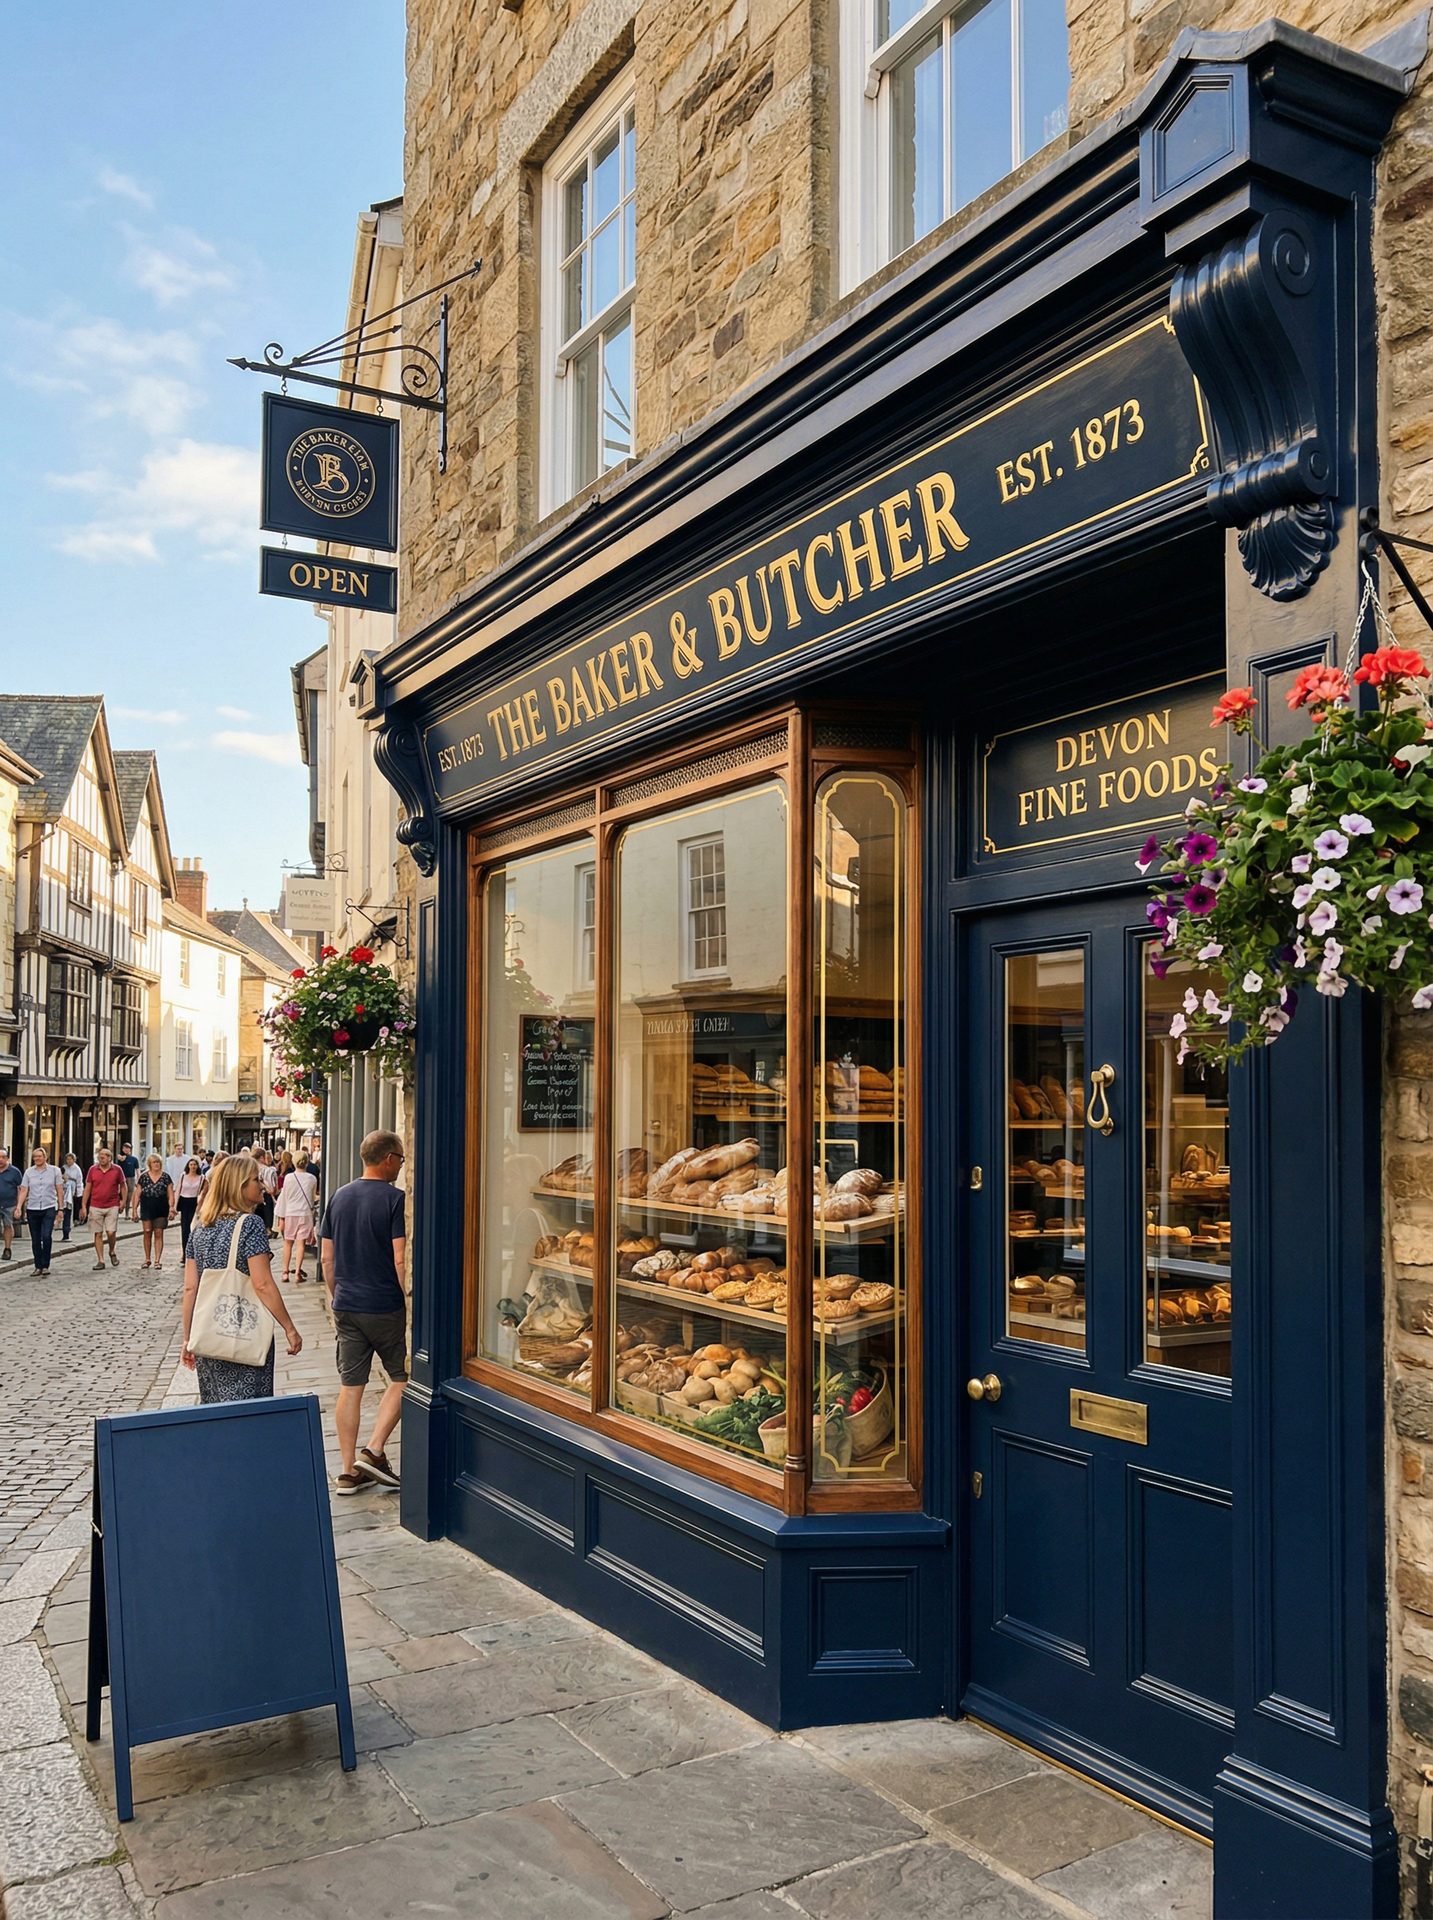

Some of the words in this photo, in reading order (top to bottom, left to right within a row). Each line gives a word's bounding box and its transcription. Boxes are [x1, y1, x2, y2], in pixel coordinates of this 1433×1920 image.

[292, 438, 312, 460] THE
[308, 432, 349, 448] BAKER
[995, 440, 1065, 504] EST.
[1068, 398, 1146, 470] 1873
[289, 562, 370, 598] OPEN
[487, 688, 547, 761] THE
[546, 631, 664, 735] BAKER
[668, 611, 704, 680] &
[707, 471, 971, 661] BUTCHER
[437, 745, 462, 773] EST.
[460, 732, 485, 763] 1873
[1055, 708, 1172, 773] DEVON
[1018, 778, 1088, 827] FINE
[1098, 747, 1220, 809] FOODS
